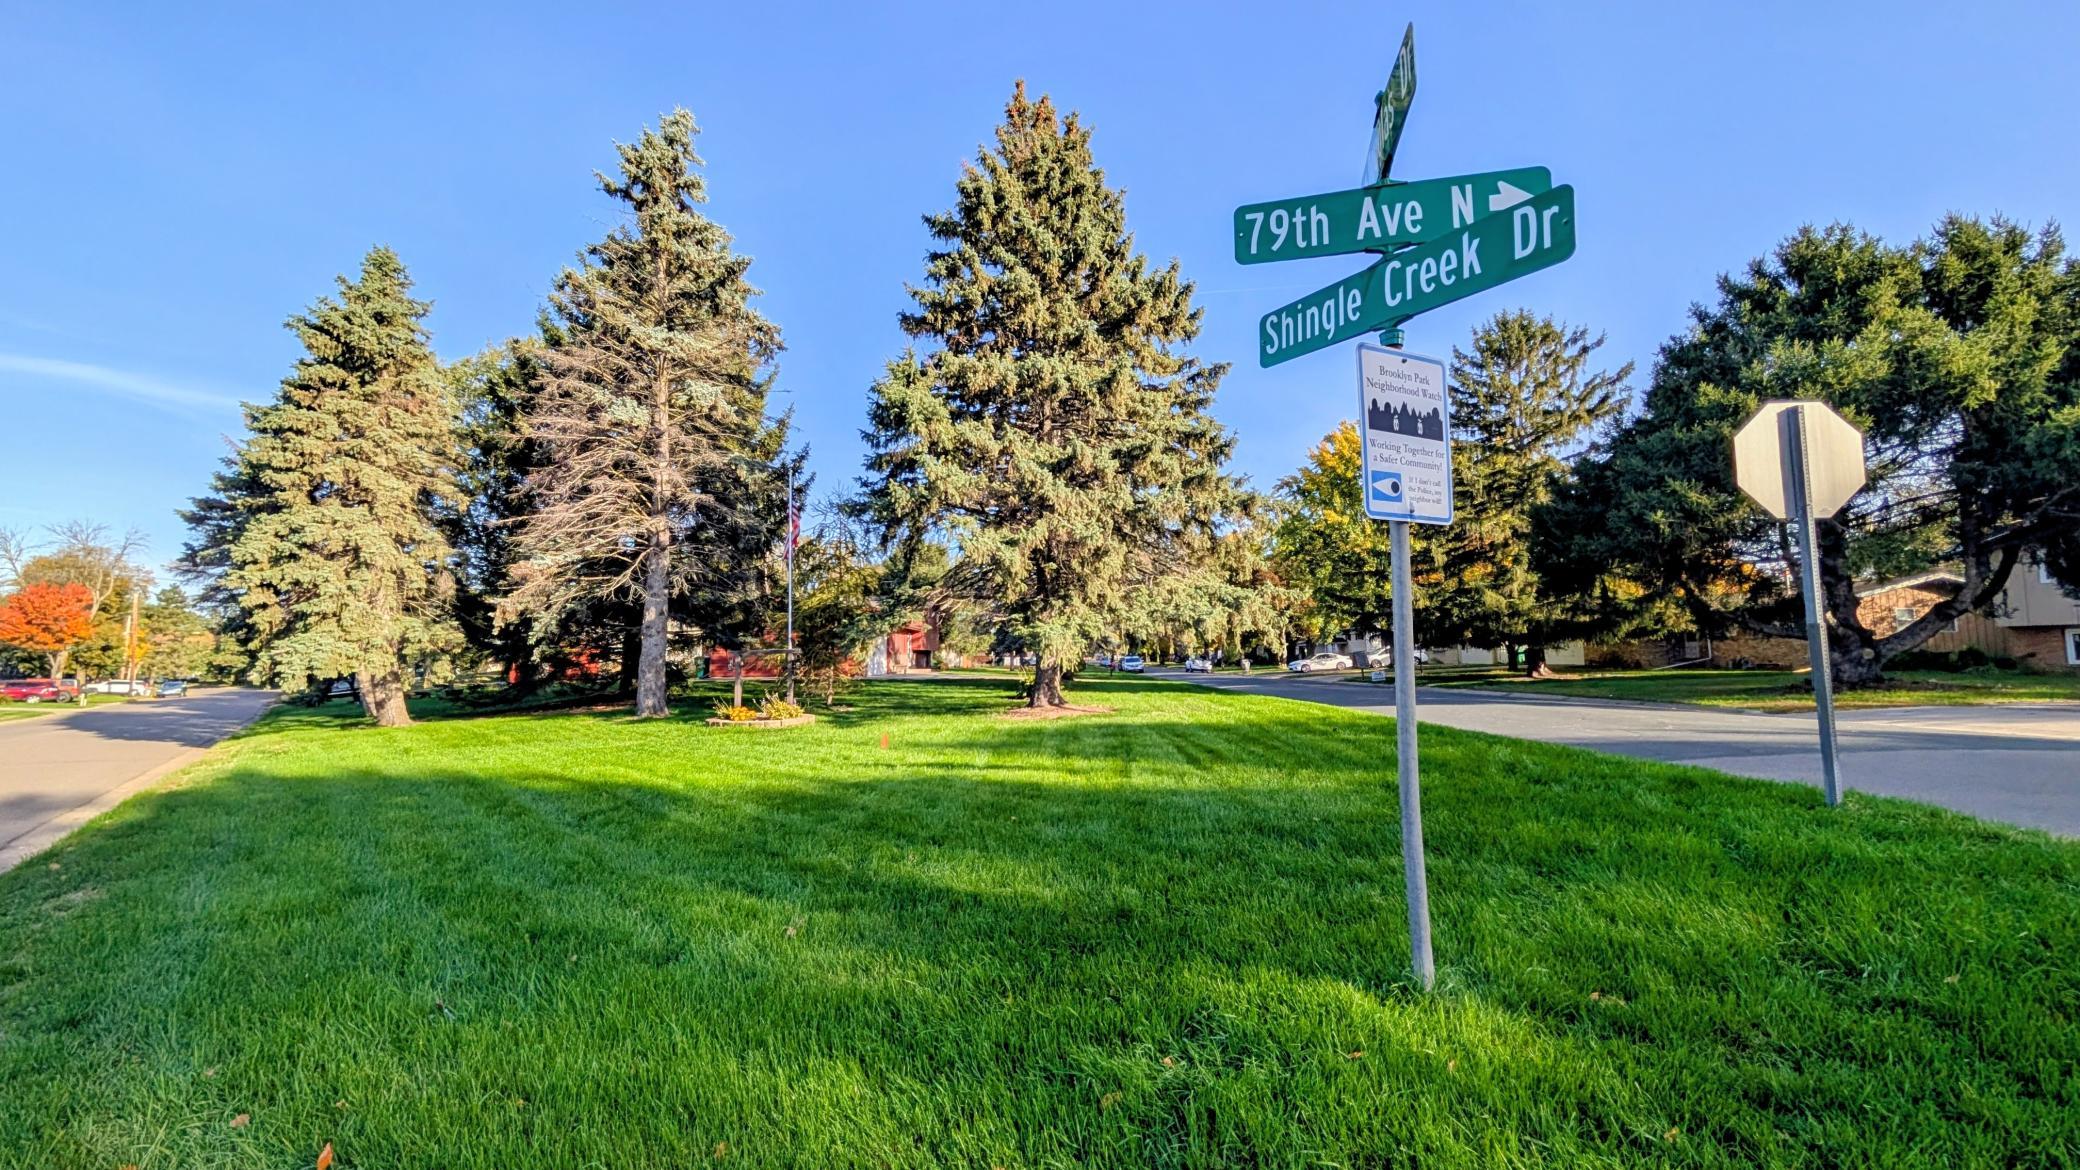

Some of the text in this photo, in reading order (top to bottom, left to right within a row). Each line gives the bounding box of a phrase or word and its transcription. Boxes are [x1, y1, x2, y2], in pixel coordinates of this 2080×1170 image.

[1245, 184, 1474, 254] 79th Ave N
[1265, 204, 1559, 355] Shingle Creek Dr
[1379, 366, 1430, 386] Brooklyn Park
[1366, 377, 1442, 401] Neighborhood Watch
[1369, 438, 1445, 459] Working Together for
[1373, 453, 1443, 473] a Safer Community!
